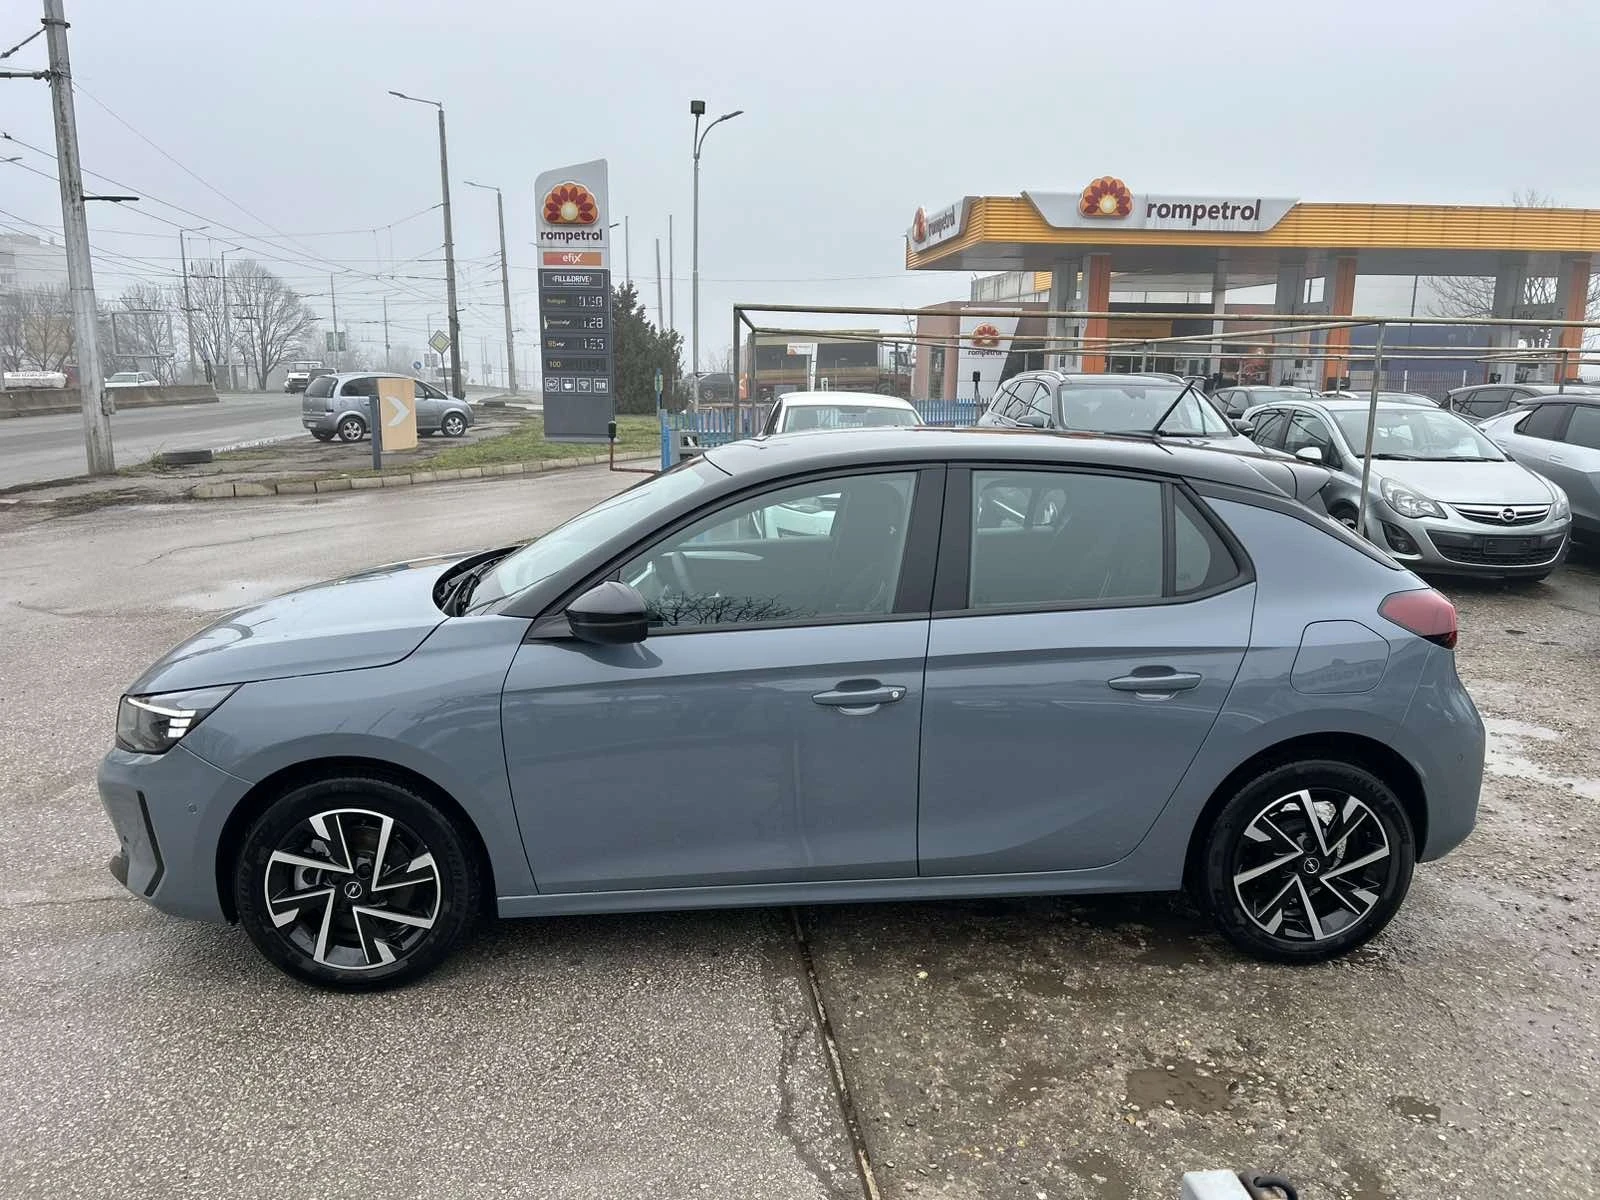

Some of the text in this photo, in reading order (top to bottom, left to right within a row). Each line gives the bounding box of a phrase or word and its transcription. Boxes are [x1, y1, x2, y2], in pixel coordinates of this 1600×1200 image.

[1146, 199, 1261, 226] rompetrol
[928, 204, 955, 238] rompetrol
[540, 229, 602, 244] rompetrol
[562, 253, 583, 264] efix
[549, 360, 561, 368] 100
